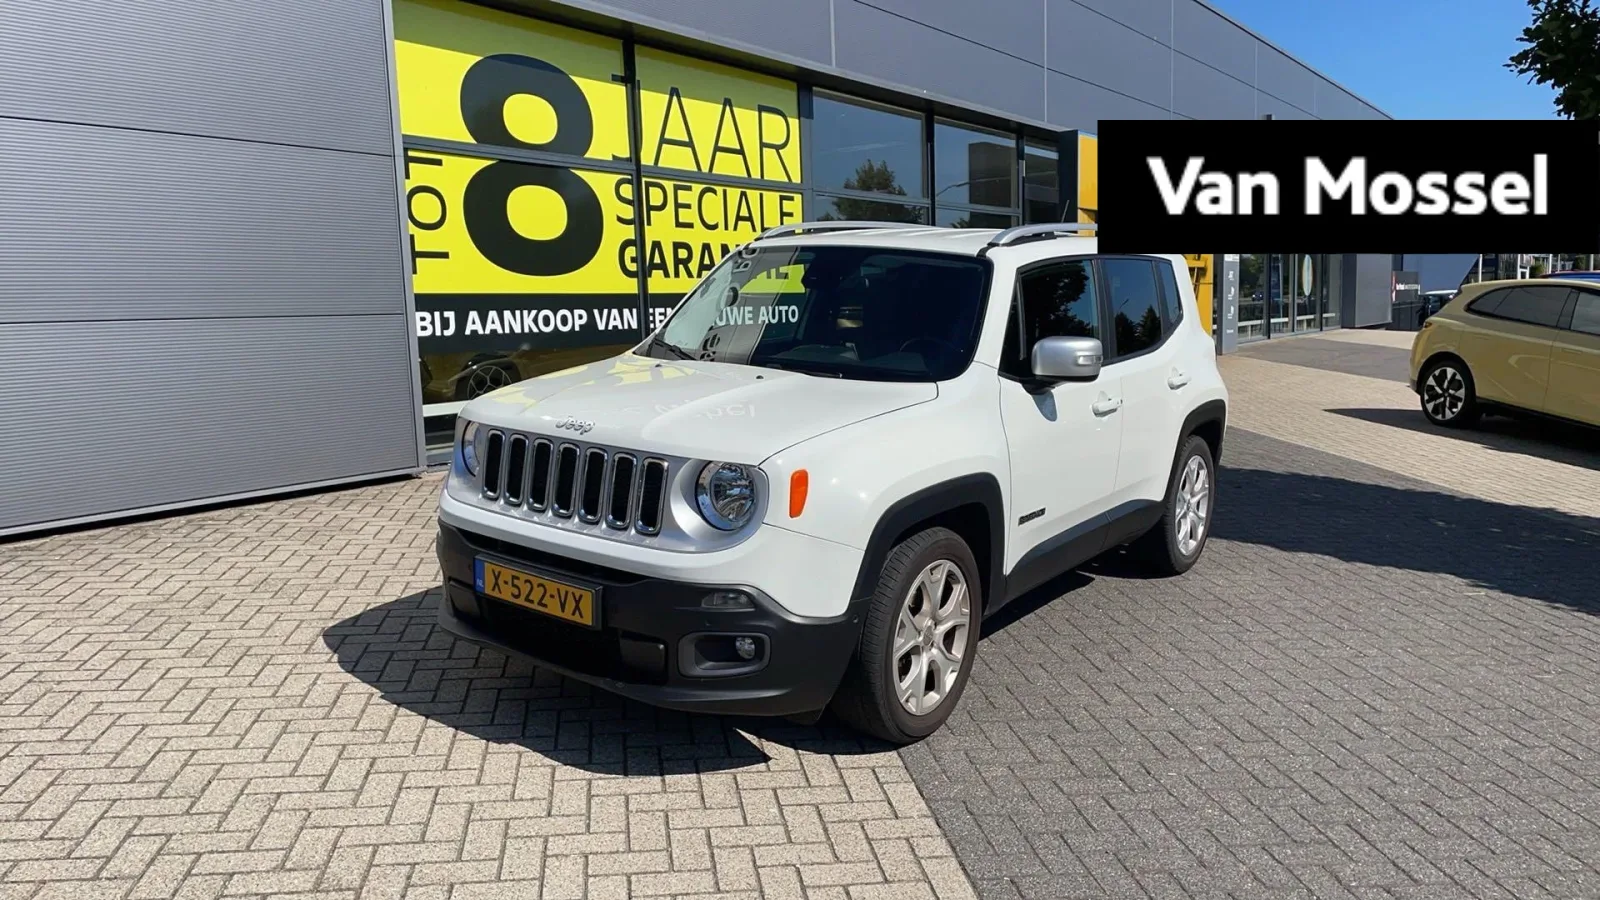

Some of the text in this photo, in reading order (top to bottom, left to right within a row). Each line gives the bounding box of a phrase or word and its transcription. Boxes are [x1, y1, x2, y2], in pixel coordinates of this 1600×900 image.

[611, 73, 793, 182] JAAR
[460, 53, 604, 277] 8
[403, 150, 450, 275] TOT
[614, 177, 795, 233] SPECIALE
[618, 238, 789, 279] GARA
[415, 310, 456, 337] BIJ
[464, 308, 588, 335] AANKOOP
[592, 308, 638, 329] VAN
[758, 305, 799, 324] AUTO
[555, 415, 595, 435] Jeep
[491, 568, 584, 619] X-522-VX
